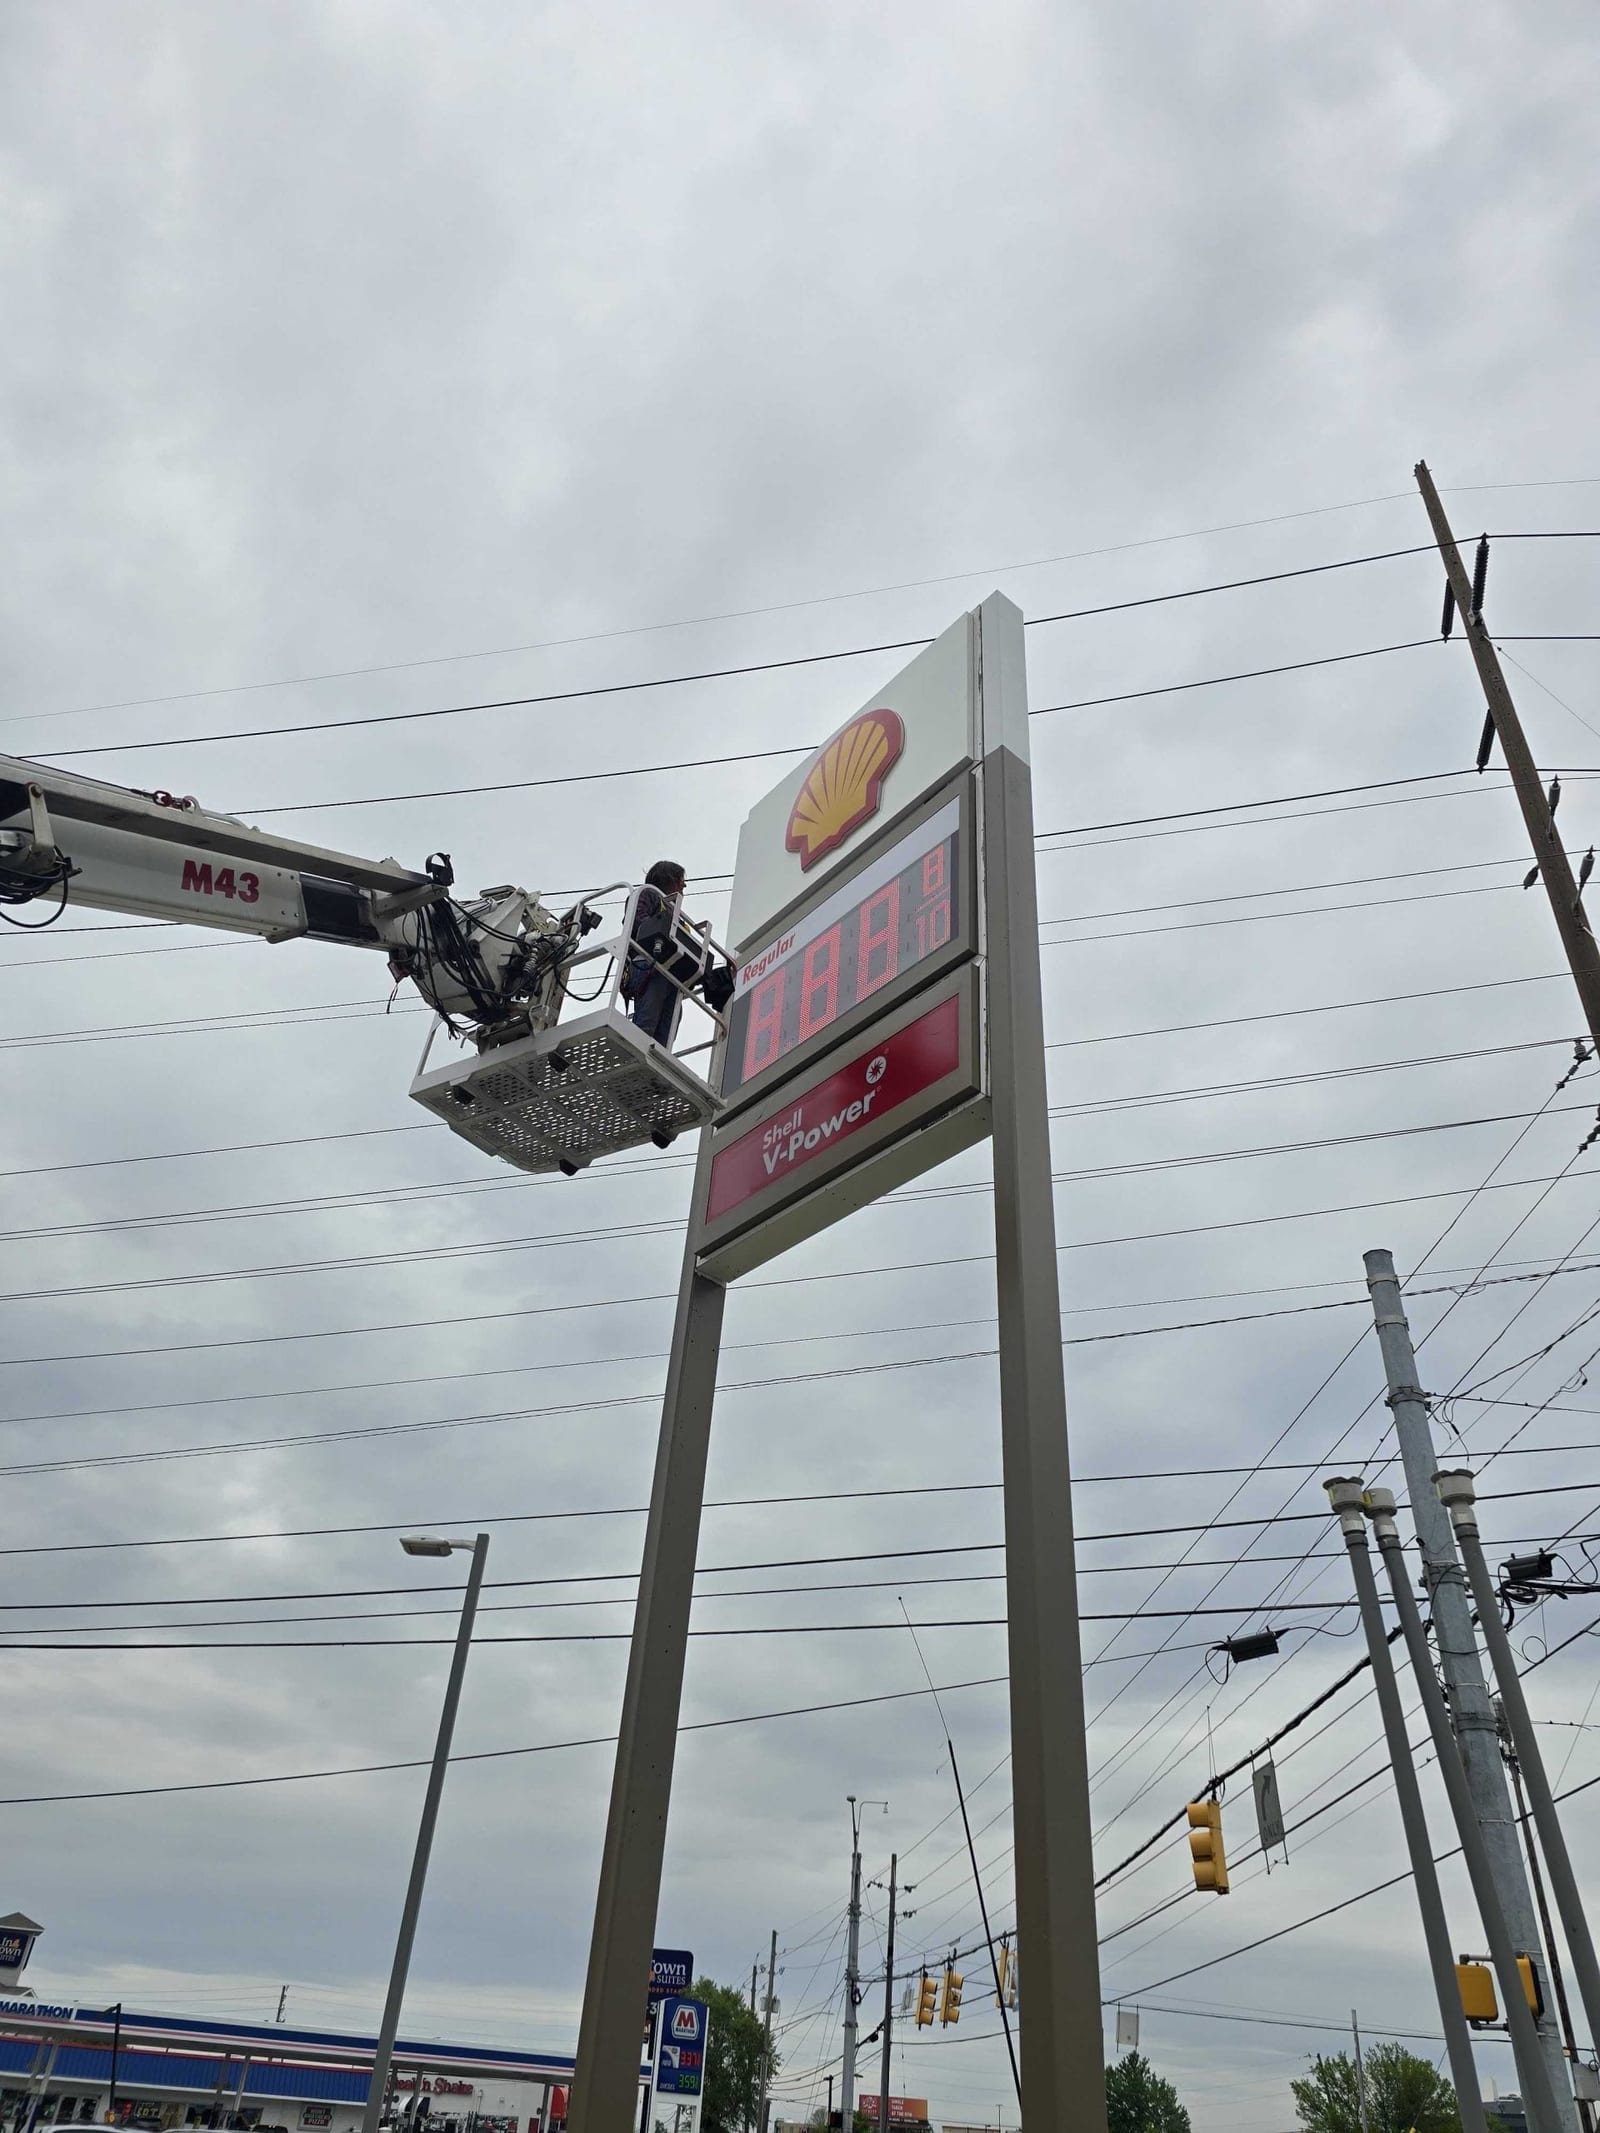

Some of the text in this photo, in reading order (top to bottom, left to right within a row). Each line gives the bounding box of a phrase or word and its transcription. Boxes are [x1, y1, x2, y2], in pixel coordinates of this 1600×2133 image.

[181, 859, 260, 904] M43
[742, 933, 796, 987] Regular
[762, 1107, 803, 1150] Shell
[762, 1089, 876, 1175] V-Power
[0, 1946, 22, 1957] own
[657, 1974, 686, 1985] SUITES
[0, 2000, 74, 2019] MARATHON
[434, 2077, 474, 2096] Shake
